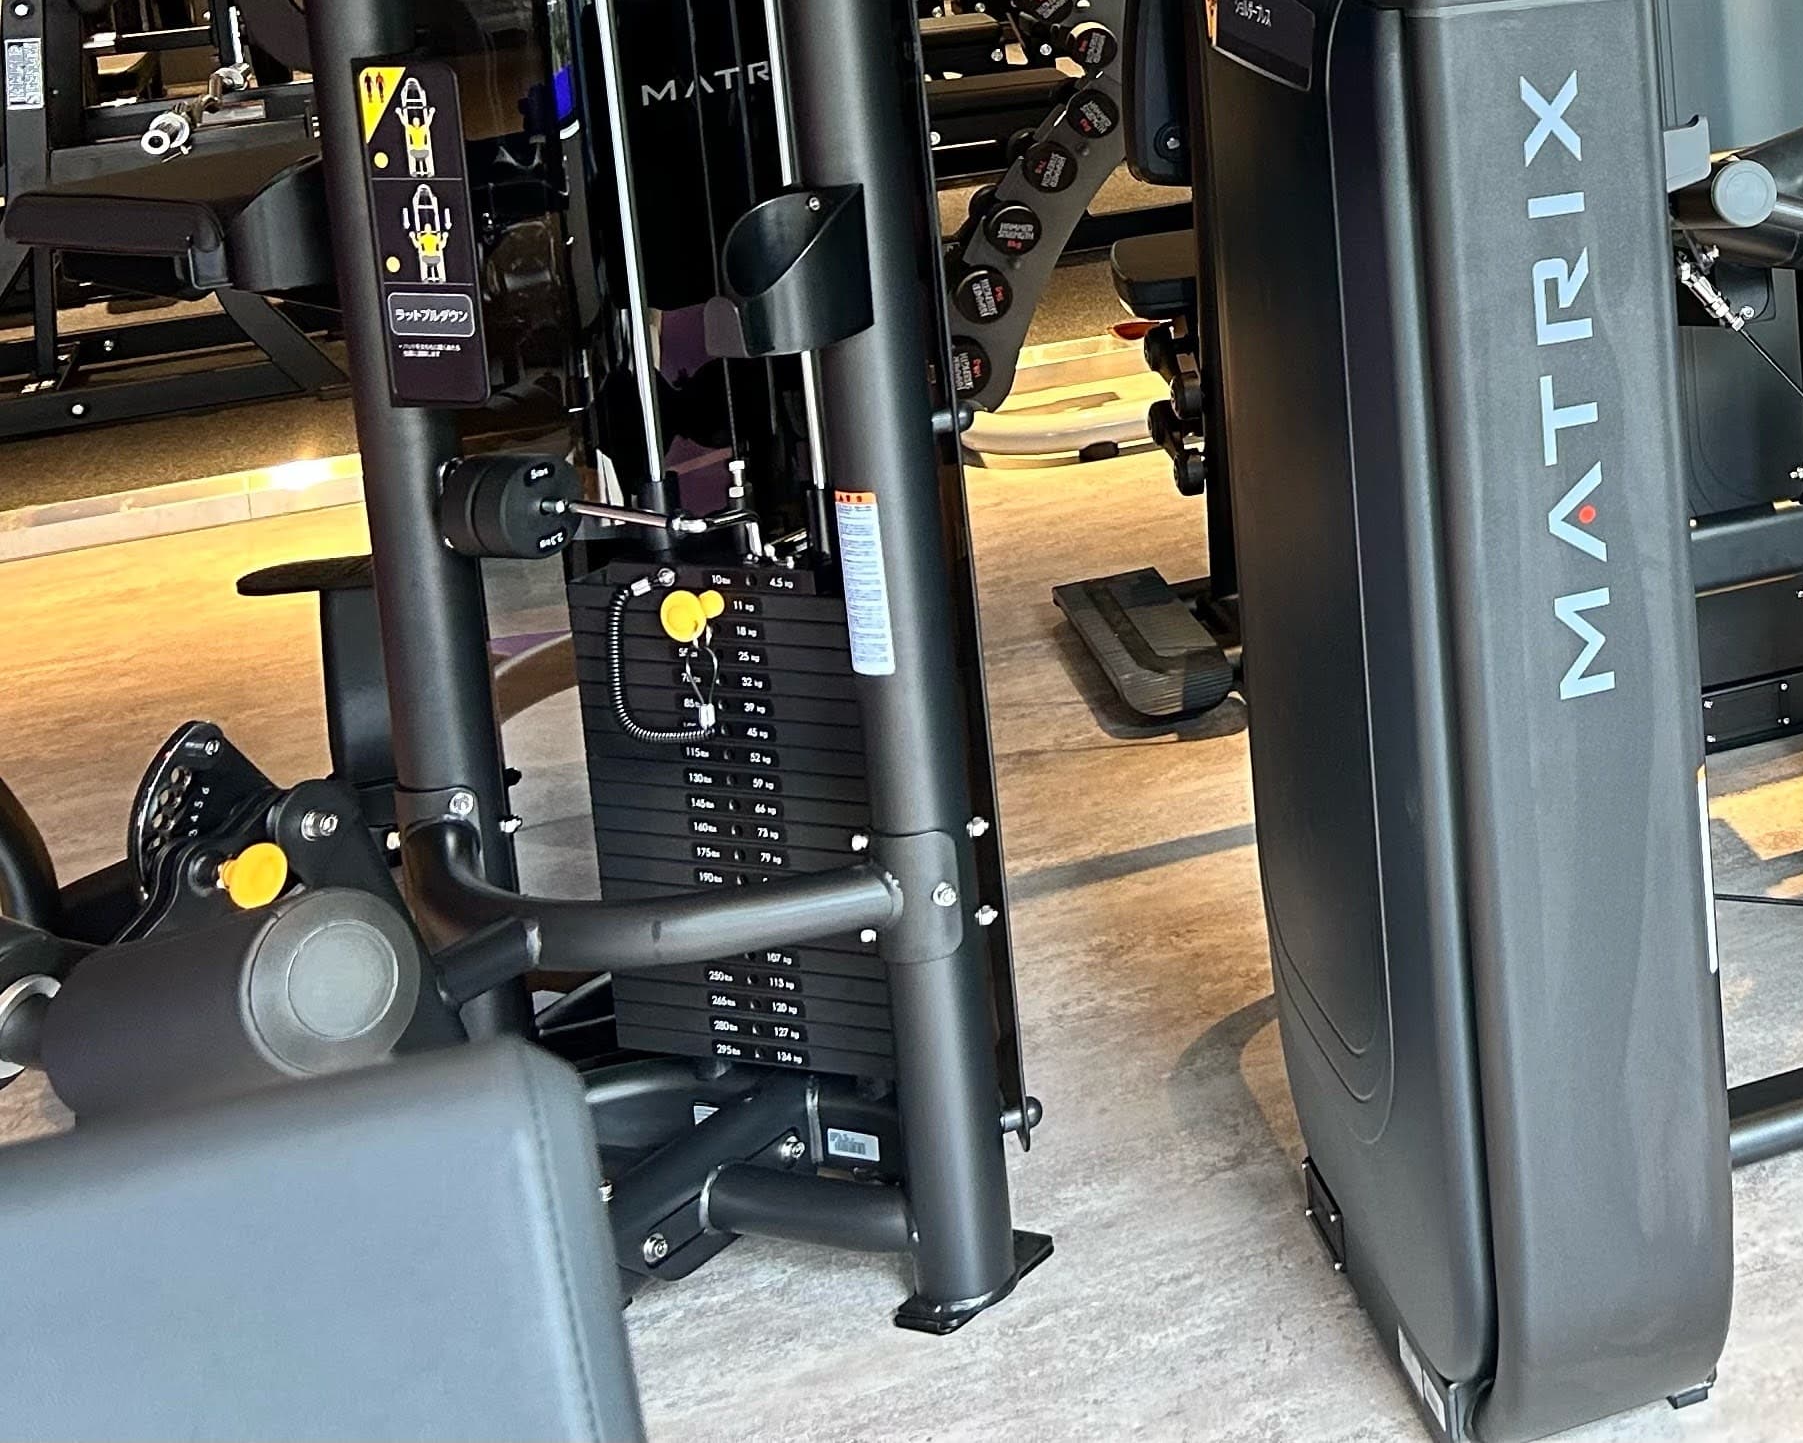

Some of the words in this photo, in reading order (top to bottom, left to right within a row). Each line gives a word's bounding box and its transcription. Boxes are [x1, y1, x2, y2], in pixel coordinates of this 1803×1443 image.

[641, 60, 770, 107] MATR
[395, 308, 468, 323] ラットプルダウン
[1519, 69, 1616, 701] MATRIX
